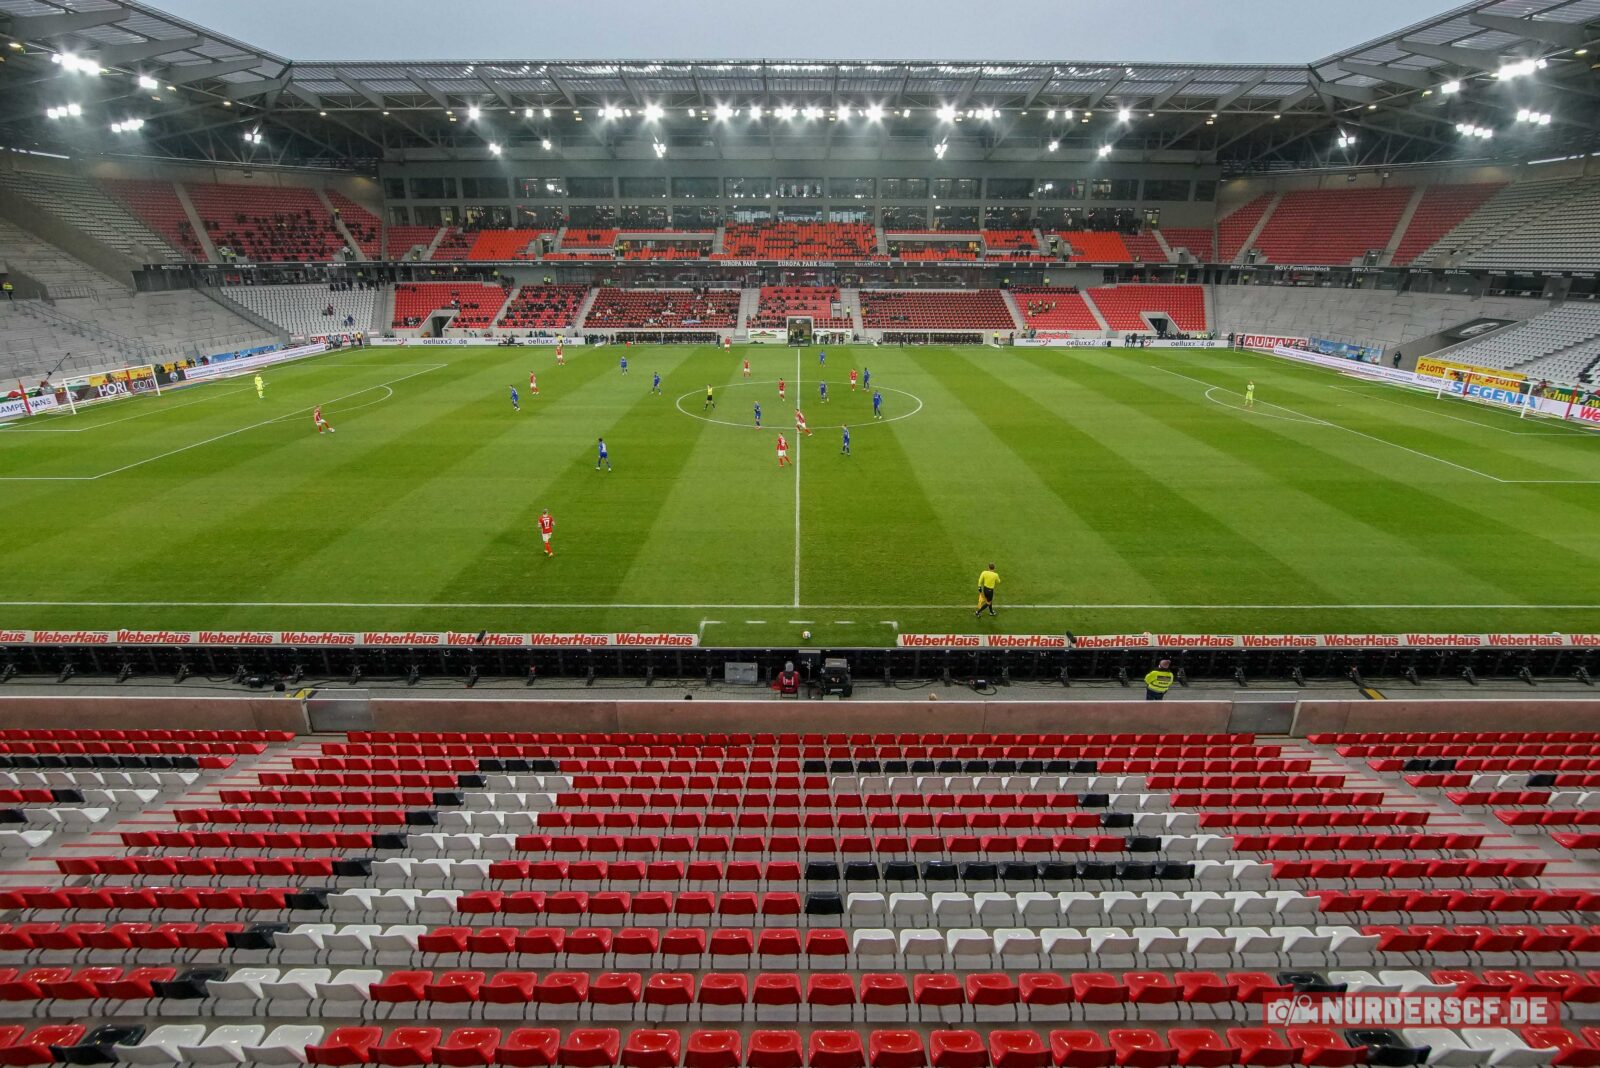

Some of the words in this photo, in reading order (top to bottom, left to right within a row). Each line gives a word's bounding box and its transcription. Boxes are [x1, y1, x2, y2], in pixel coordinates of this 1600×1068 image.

[1452, 381, 1537, 409] SEGENIA
[33, 631, 109, 643] WeberHaus
[116, 631, 191, 643] WeberHaus
[199, 631, 273, 643] WeberHaus
[280, 632, 355, 644] WeberHaus
[363, 632, 439, 644] WeberHaus
[531, 634, 608, 645] WeberHaus
[616, 633, 693, 645] WeberHaus
[902, 634, 980, 646] WeberHaus
[987, 635, 1065, 646] WeberHaus
[1074, 635, 1149, 647] WeberHaus
[1157, 635, 1234, 646] WeberHaus
[1241, 635, 1317, 646] WeberHaus
[1324, 634, 1399, 646] WeberHaus
[1406, 634, 1481, 645] WeberHaus
[1488, 634, 1563, 645] WeberHaus
[1570, 634, 1600, 645] Web
